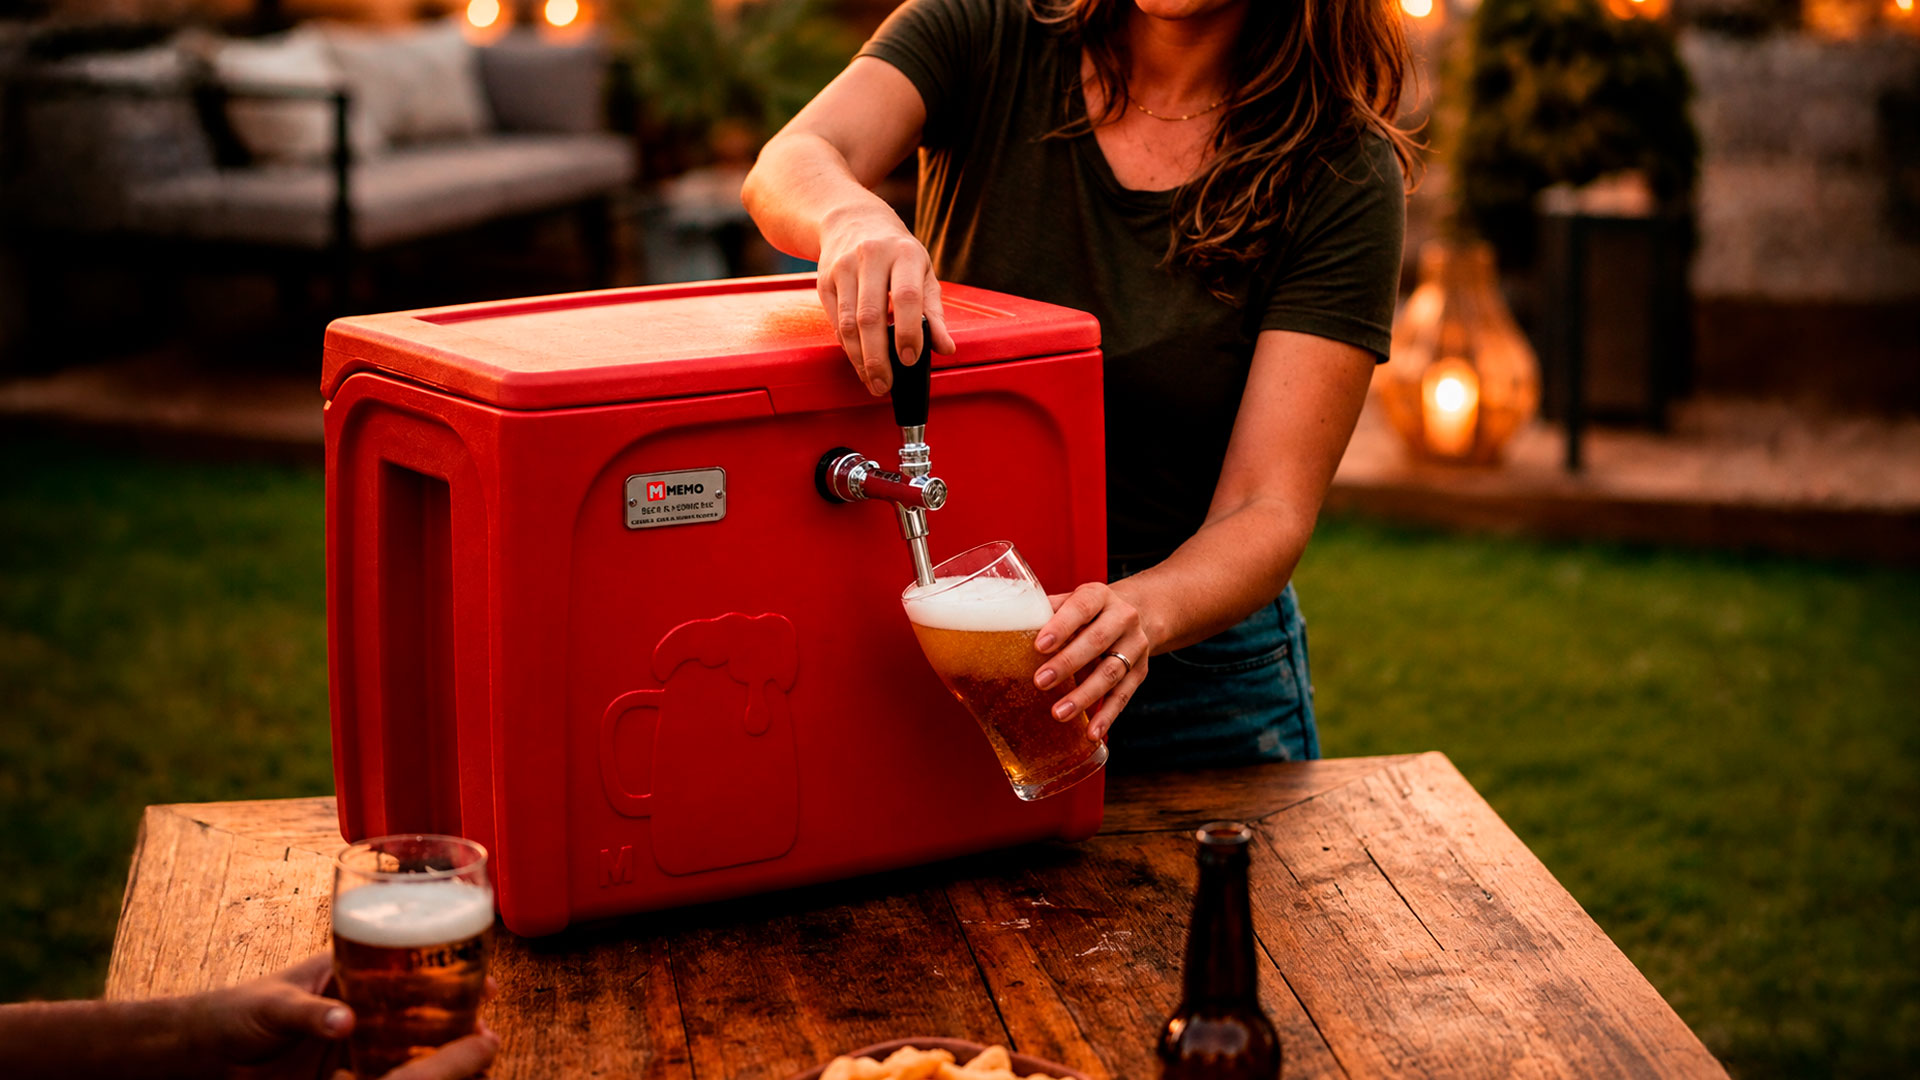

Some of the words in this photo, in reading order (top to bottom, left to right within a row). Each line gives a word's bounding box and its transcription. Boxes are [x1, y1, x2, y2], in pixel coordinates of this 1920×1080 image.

[649, 484, 663, 499] M
[666, 483, 704, 497] MEMO
[600, 845, 633, 889] M
